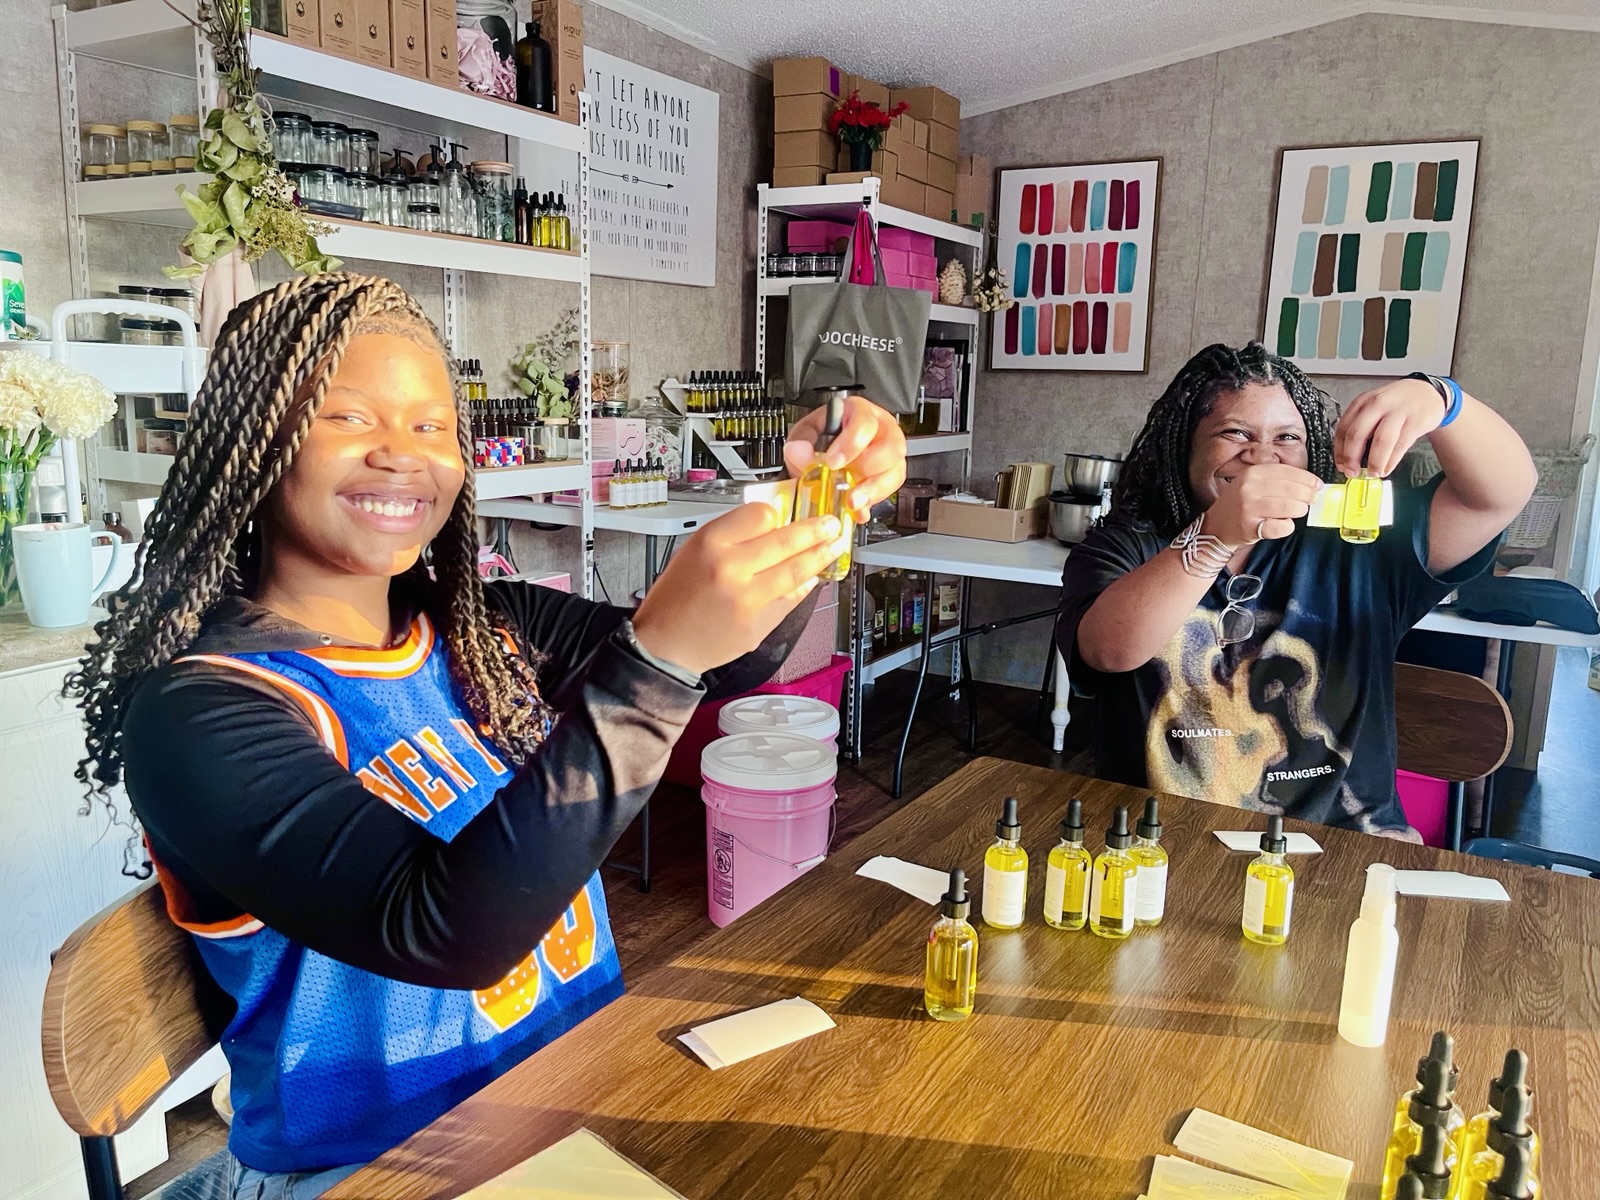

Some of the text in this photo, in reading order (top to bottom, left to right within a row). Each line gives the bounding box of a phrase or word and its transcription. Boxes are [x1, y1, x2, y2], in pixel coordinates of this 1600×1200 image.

[612, 75, 634, 103] LET
[644, 87, 689, 122] ANYONE
[610, 105, 639, 134] LESS
[648, 118, 660, 140] OF
[669, 125, 689, 148] YOU
[613, 138, 630, 163] YOU
[637, 143, 652, 168] ARE
[622, 193, 630, 206] TO
[633, 195, 645, 210] ALL
[649, 197, 680, 216] BELIEVERS
[682, 205, 689, 217] IN
[620, 212, 628, 226] IN
[631, 214, 641, 229] THE
[645, 217, 658, 231] WAY
[661, 220, 671, 234] YOU
[607, 231, 621, 246] YOUR
[643, 238, 654, 251] AND
[656, 239, 668, 253] YOUR
[1266, 764, 1336, 782] STRANGERS.
